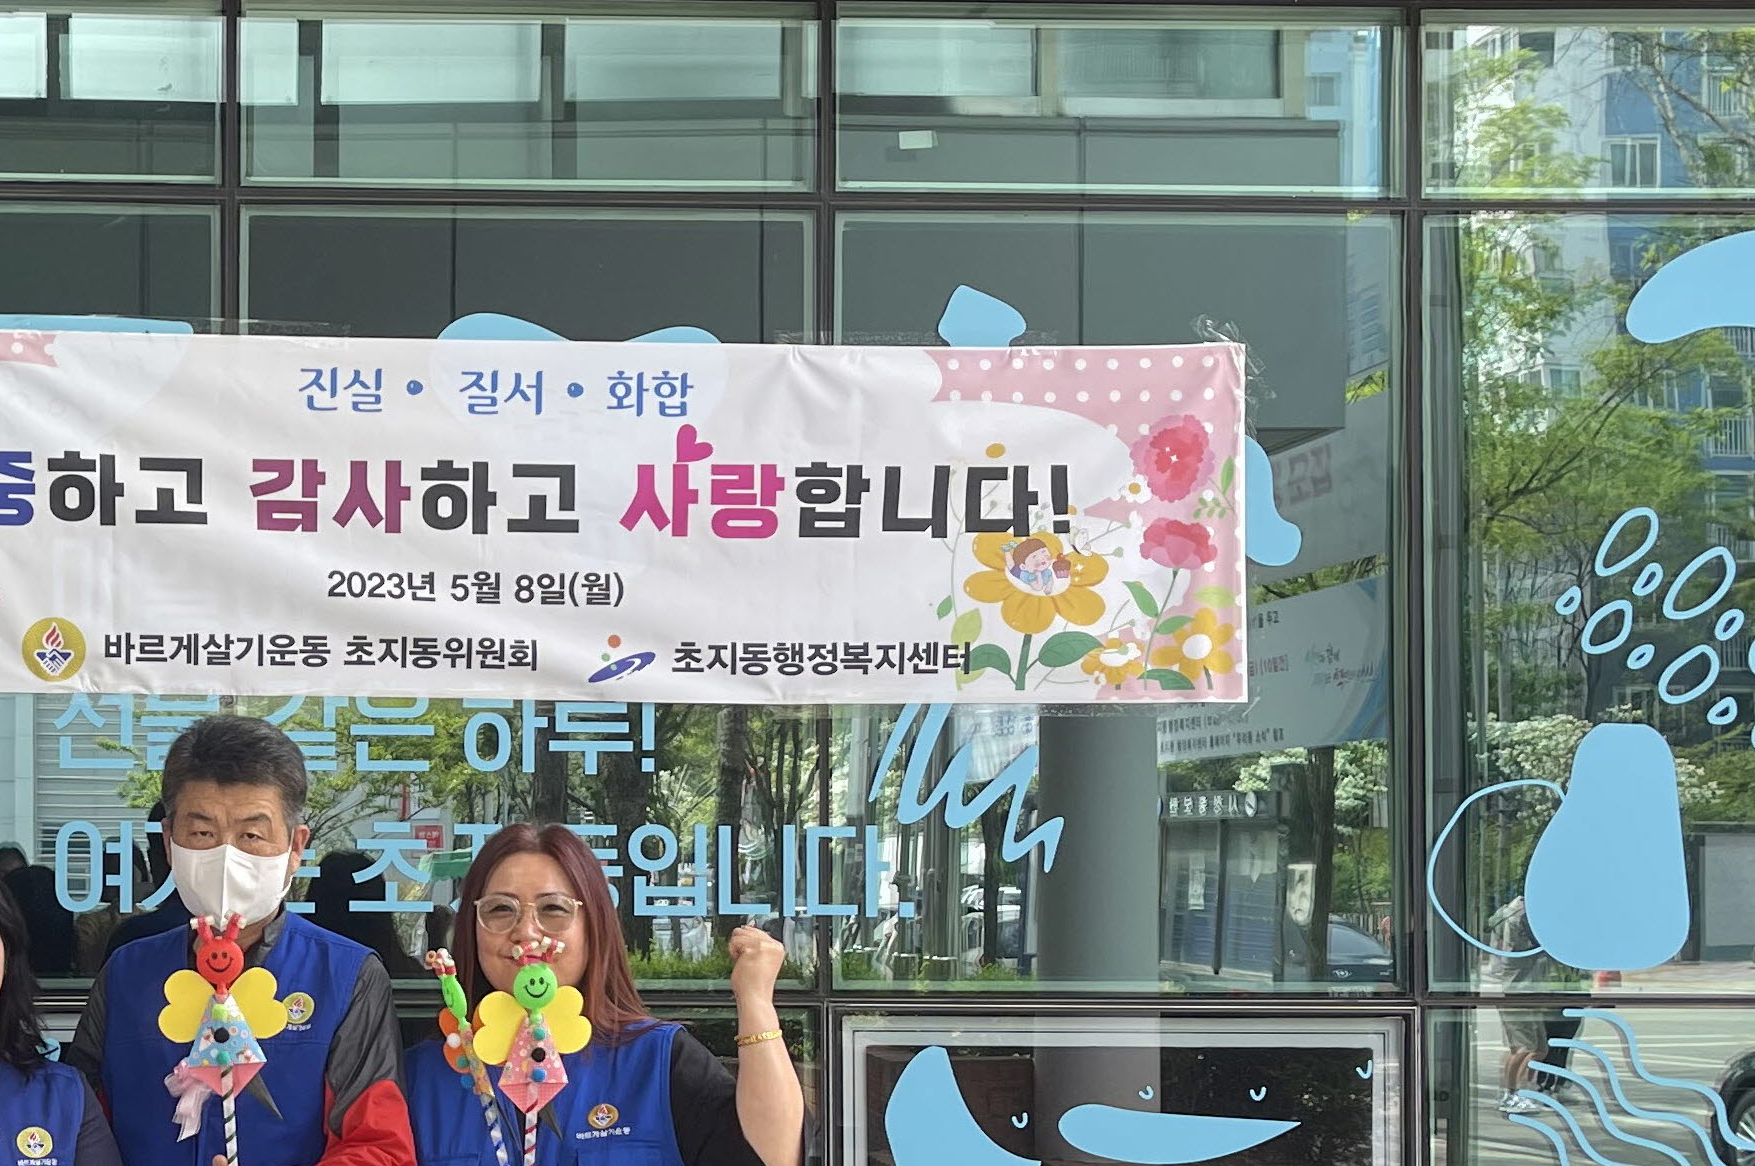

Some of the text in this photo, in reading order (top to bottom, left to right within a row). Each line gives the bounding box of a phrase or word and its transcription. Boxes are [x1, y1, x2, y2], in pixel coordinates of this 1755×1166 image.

[296, 366, 694, 418] 진실 질서 화합
[248, 457, 581, 537] 감사하고
[619, 460, 1071, 540] 사랑합니다!
[326, 569, 625, 609] 2023년 5월 8일(월)
[103, 631, 539, 673] 바르게살기운동 초지동위원회
[670, 640, 972, 677] 초지동행정복지센터
[348, 821, 915, 918] 초입니다.
